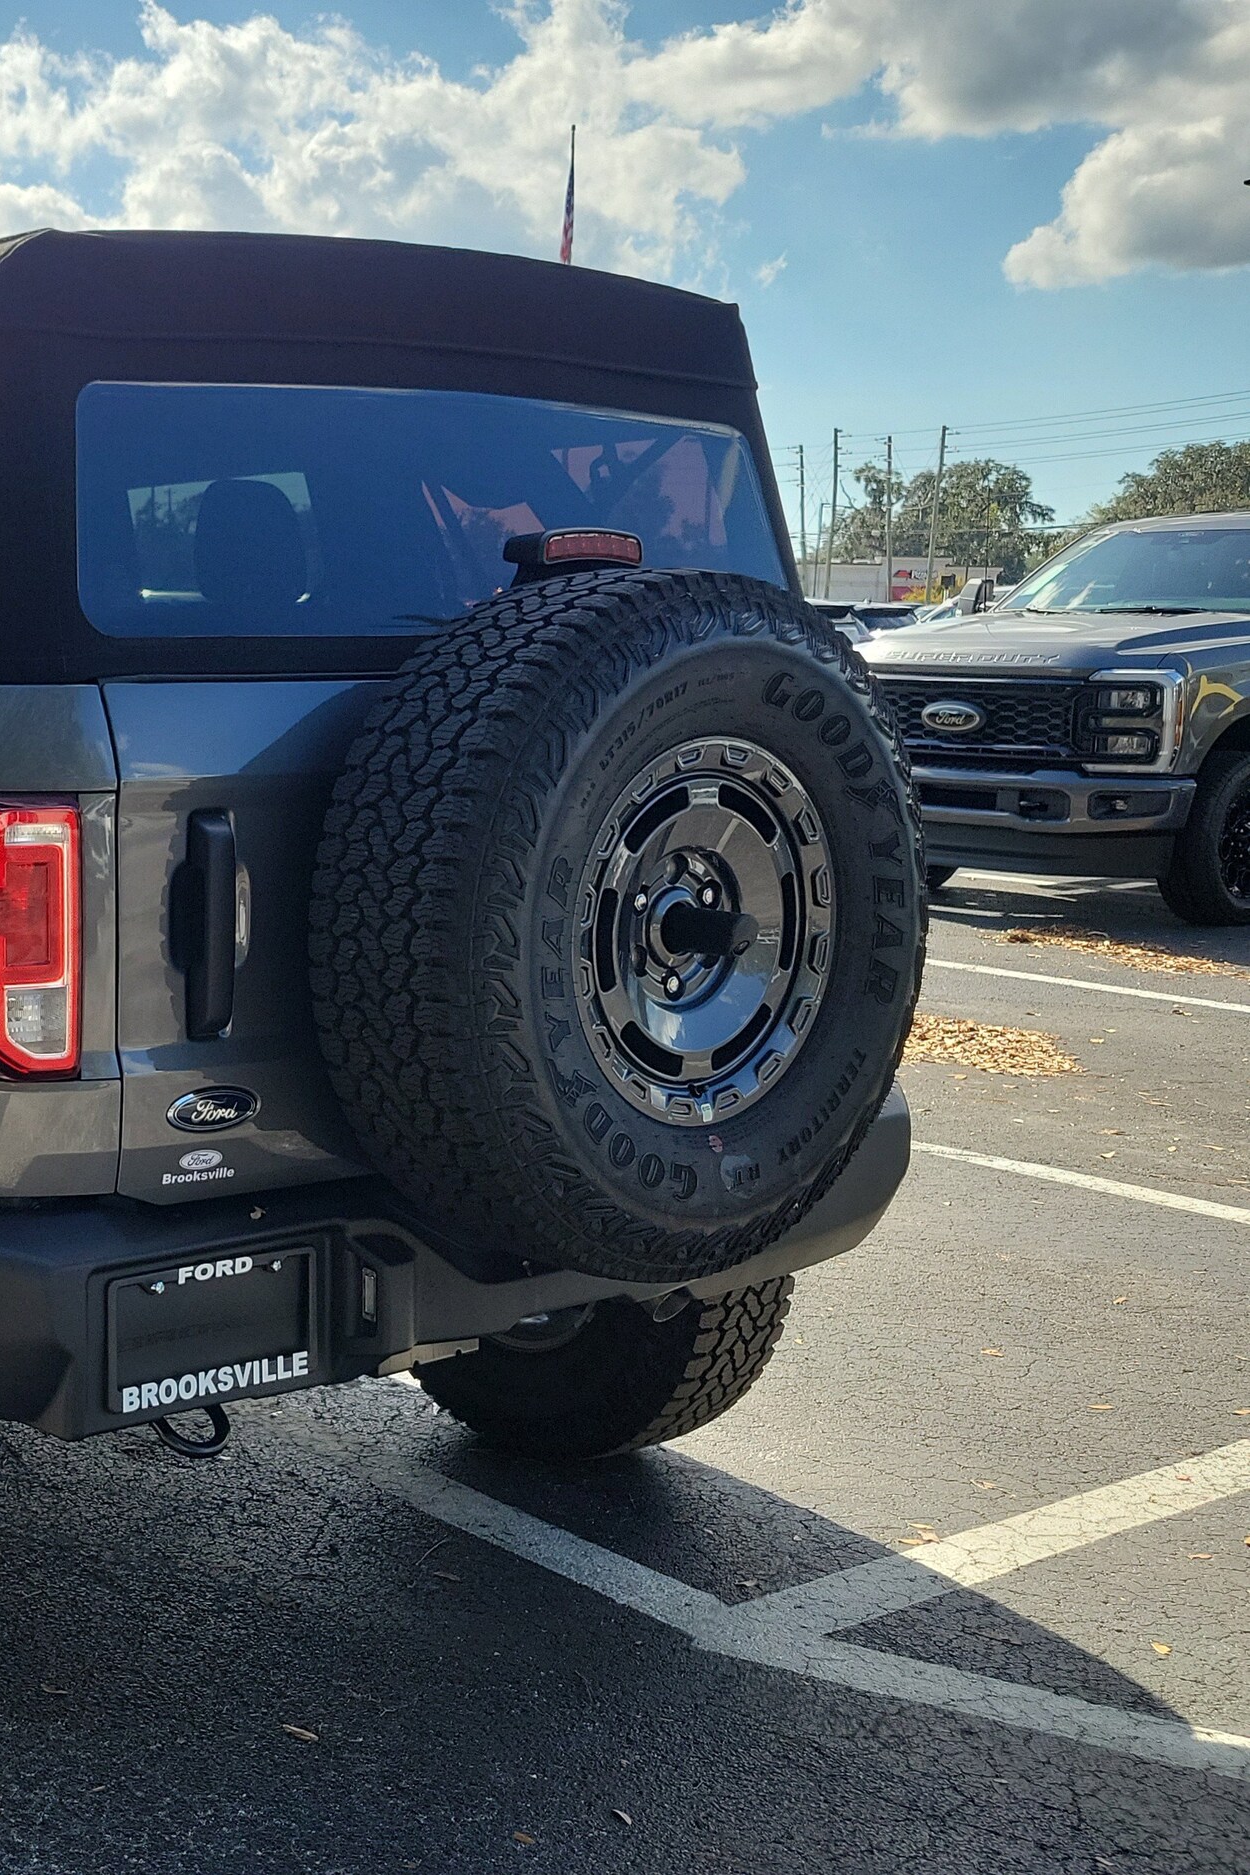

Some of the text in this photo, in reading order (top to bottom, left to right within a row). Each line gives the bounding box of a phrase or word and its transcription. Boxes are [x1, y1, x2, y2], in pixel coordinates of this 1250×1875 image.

[886, 651, 1061, 665] SUPER DUTY
[935, 710, 966, 726] Ford
[760, 668, 906, 1006] GOODYEAR
[541, 855, 699, 1201] GOODYEAR
[191, 1097, 238, 1123] Ford
[187, 1153, 216, 1167] Ford
[162, 1167, 235, 1185] Brooksville
[178, 1256, 253, 1285] FORD
[122, 1351, 309, 1413] BROOKSVILLE
